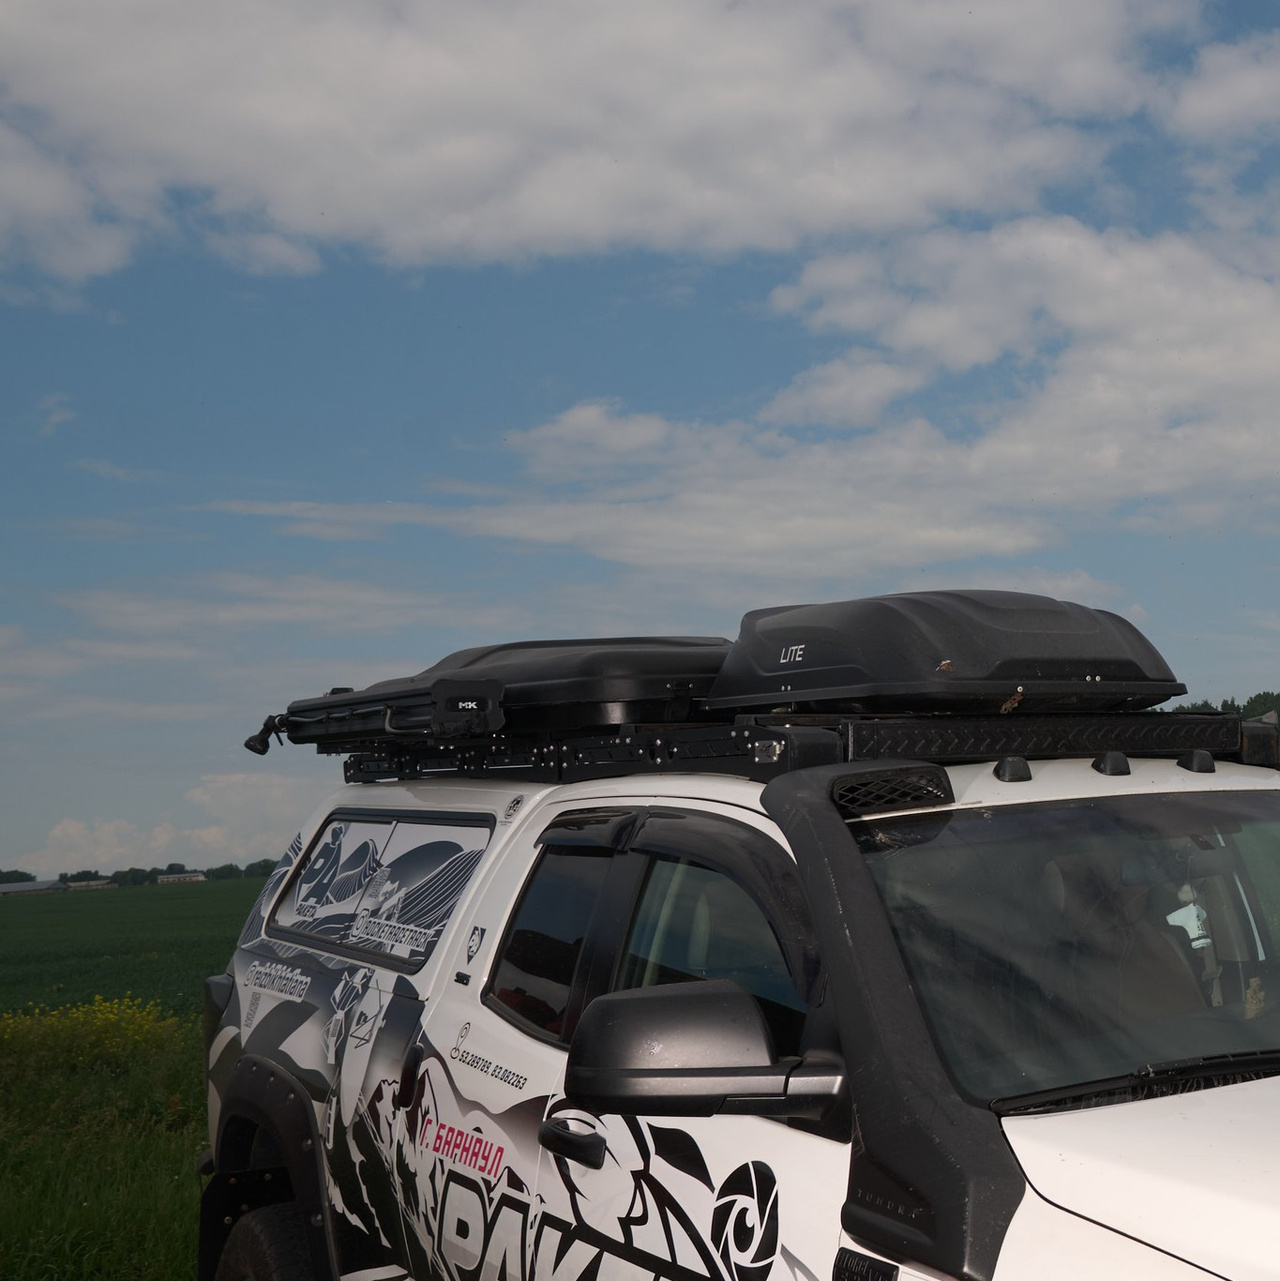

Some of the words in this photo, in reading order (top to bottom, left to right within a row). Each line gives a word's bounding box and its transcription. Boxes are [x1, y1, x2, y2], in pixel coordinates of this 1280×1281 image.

[780, 644, 805, 664] LITE
[458, 701, 478, 710] MK
[490, 1064, 528, 1091] 83.082263
[432, 1122, 505, 1179] БАРНАУЛ
